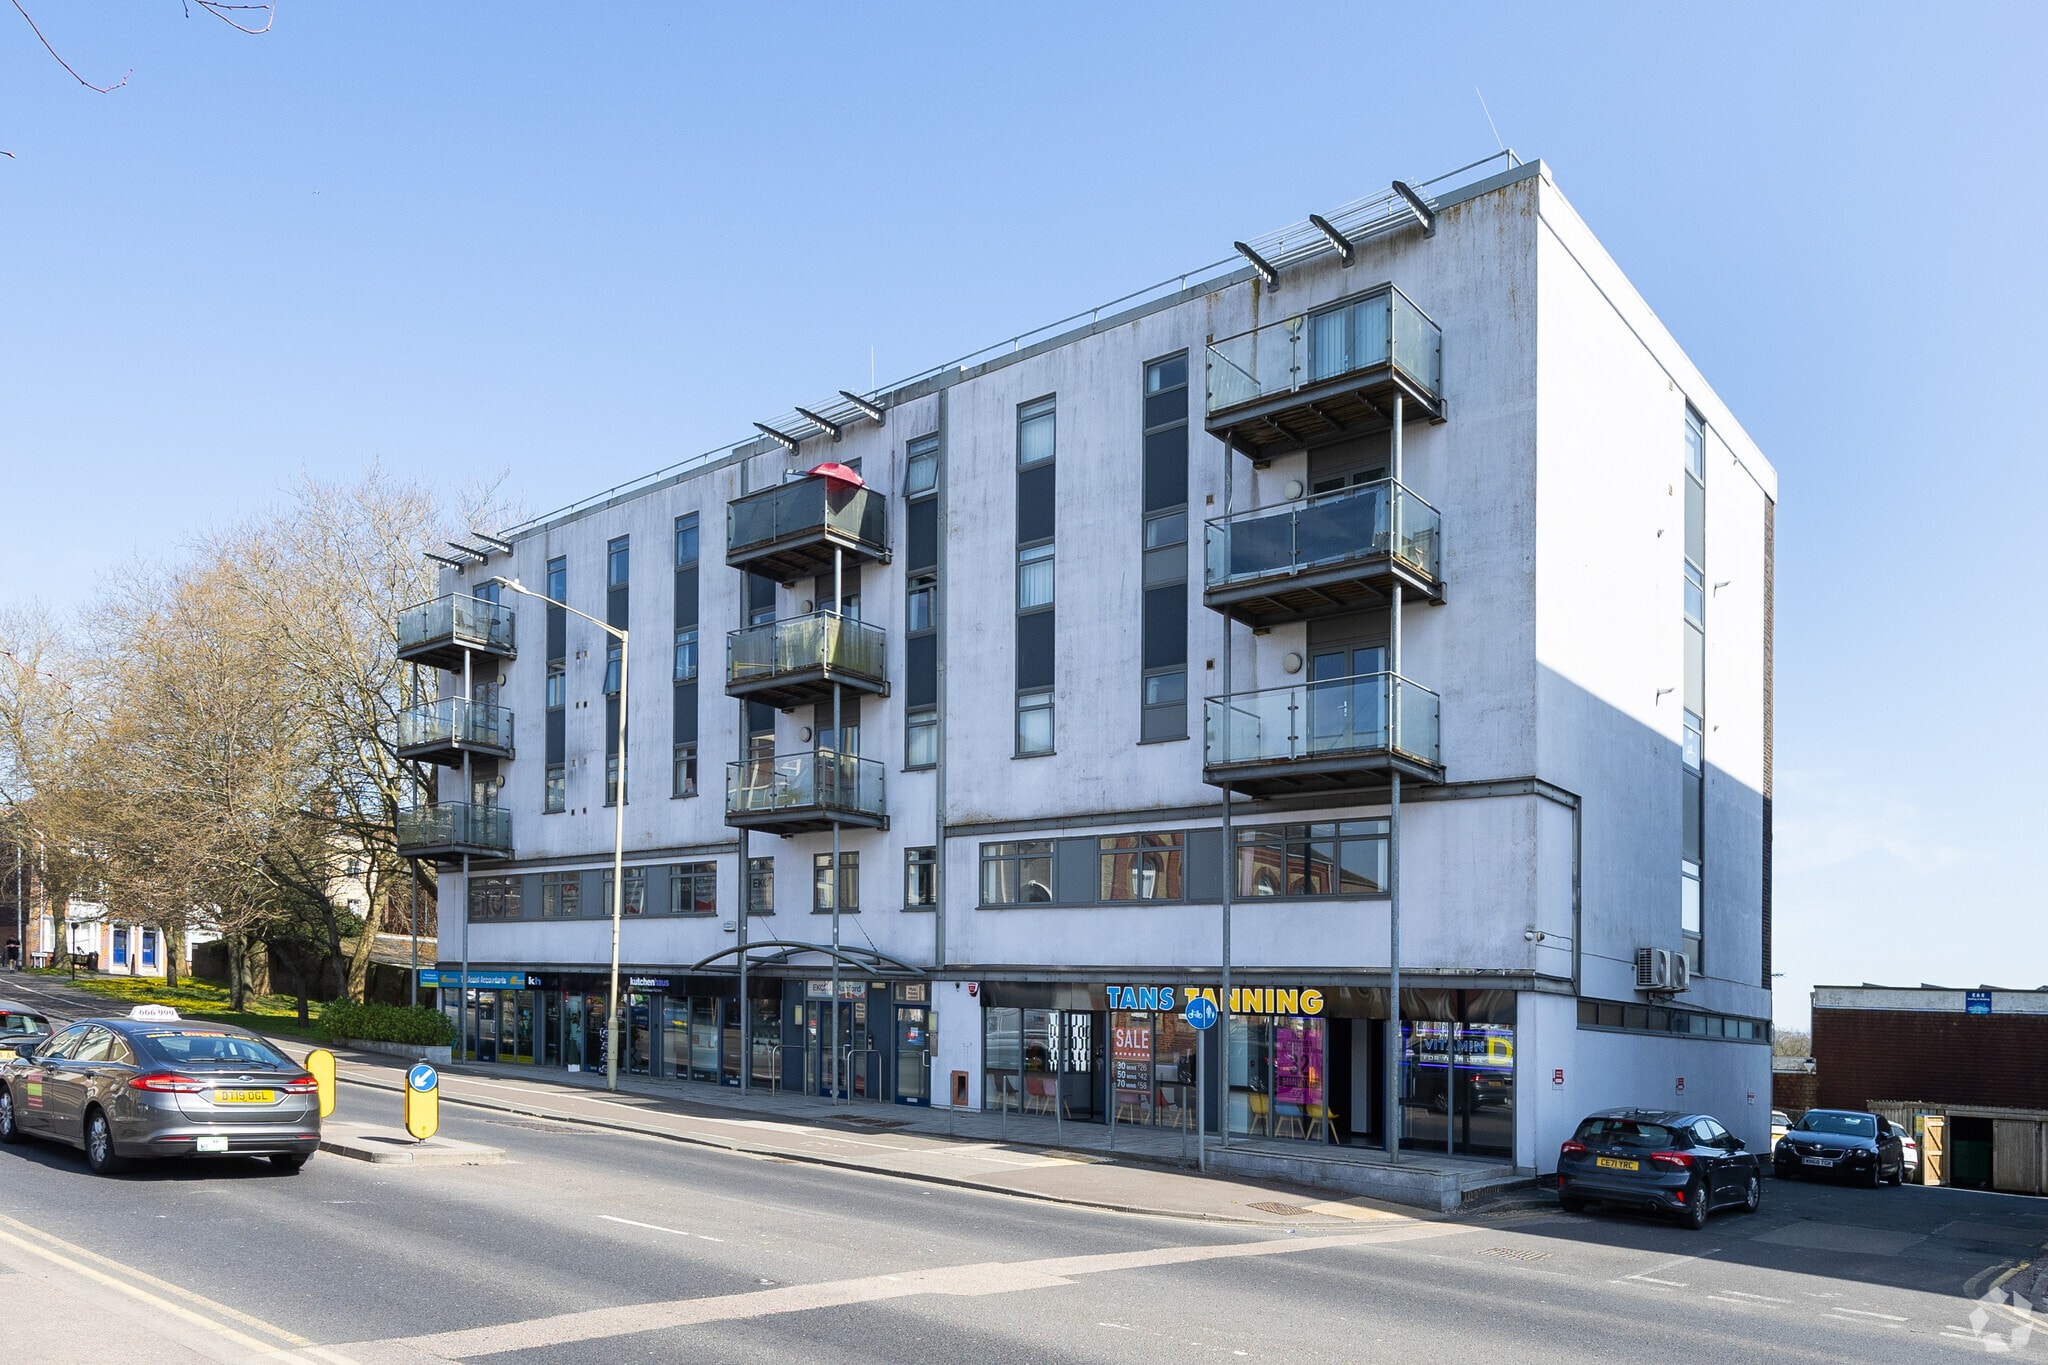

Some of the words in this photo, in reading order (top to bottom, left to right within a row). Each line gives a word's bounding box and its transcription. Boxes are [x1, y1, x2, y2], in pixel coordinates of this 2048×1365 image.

[1106, 986, 1174, 1011] TANS
[1116, 1029, 1149, 1049] SALE
[1488, 1037, 1513, 1065] D
[1117, 1062, 1126, 1070] 30
[1117, 1071, 1126, 1079] 50
[1117, 1080, 1126, 1088] 70
[221, 1091, 245, 1101] DT19
[248, 1092, 268, 1100] OGL
[1600, 1158, 1617, 1167] CE71
[1617, 1160, 1634, 1169] YRC
